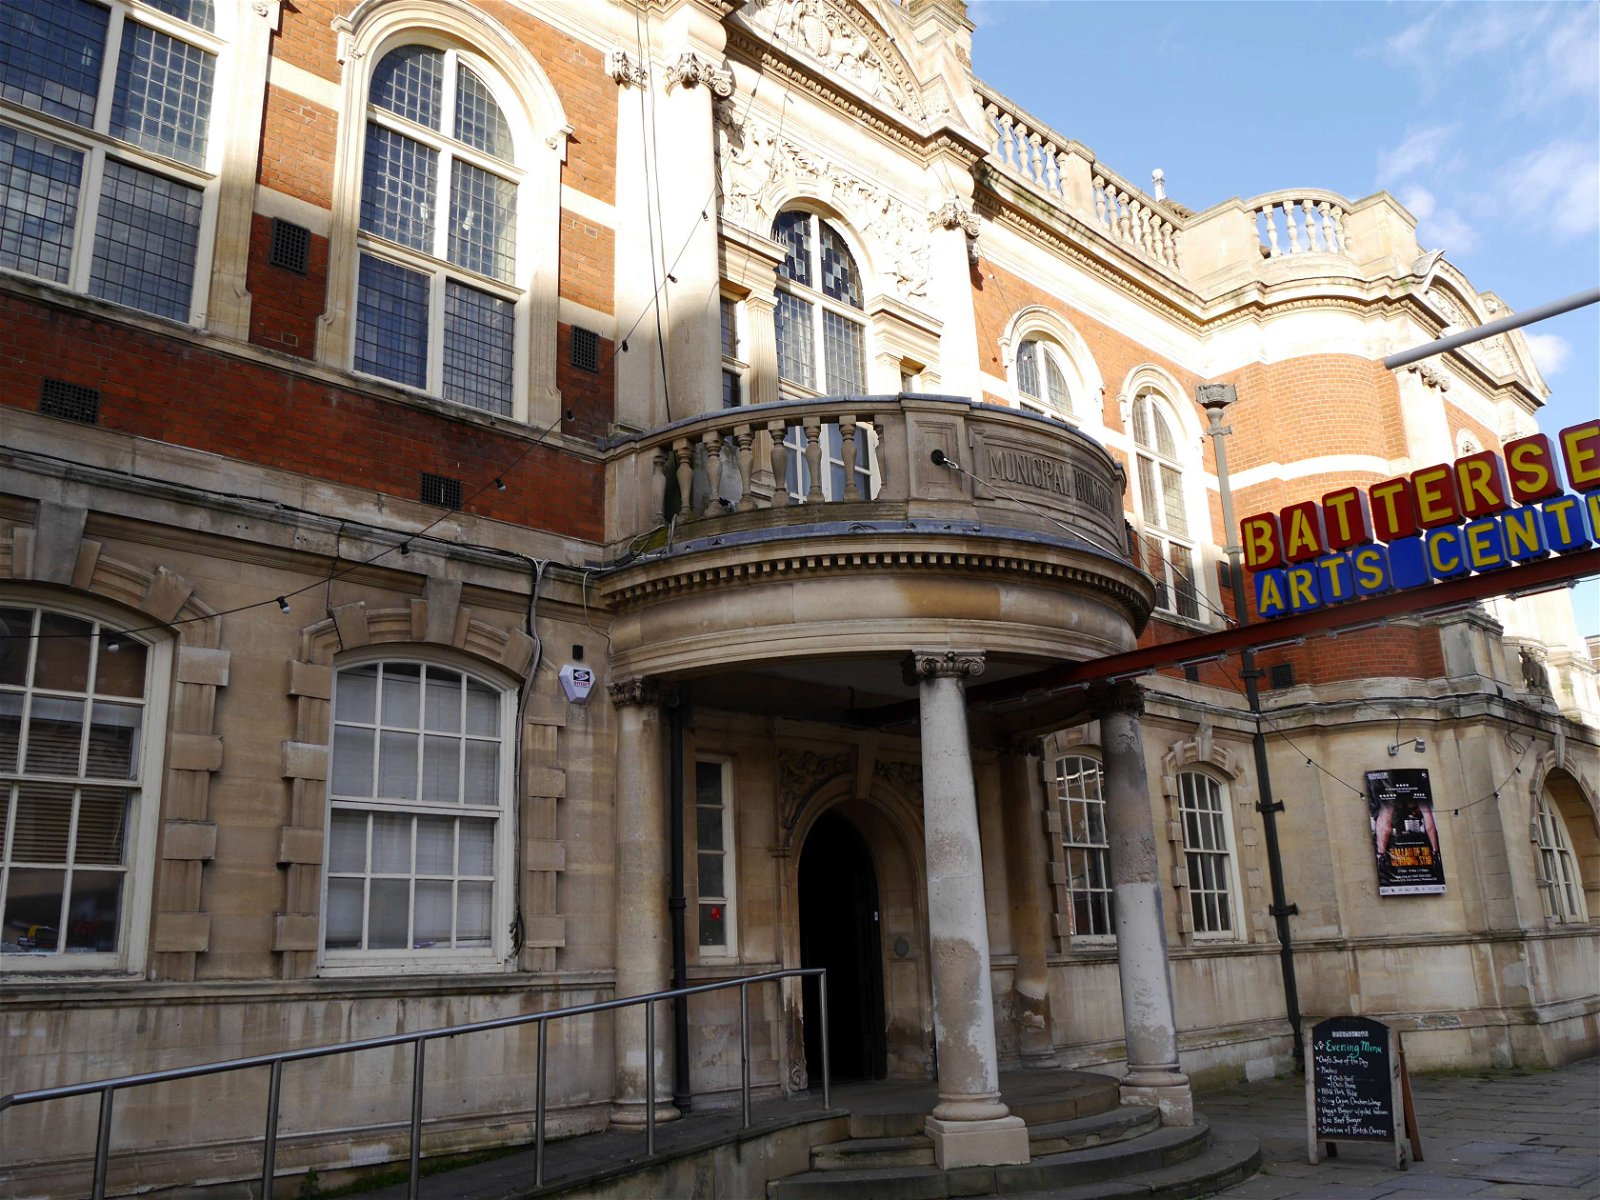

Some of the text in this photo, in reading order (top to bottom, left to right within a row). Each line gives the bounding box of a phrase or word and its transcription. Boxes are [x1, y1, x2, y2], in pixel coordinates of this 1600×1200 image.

[987, 449, 1072, 496] MUNICIPAL
[1259, 551, 1384, 613] ARTS
[1326, 1040, 1383, 1058] Evening Menu
